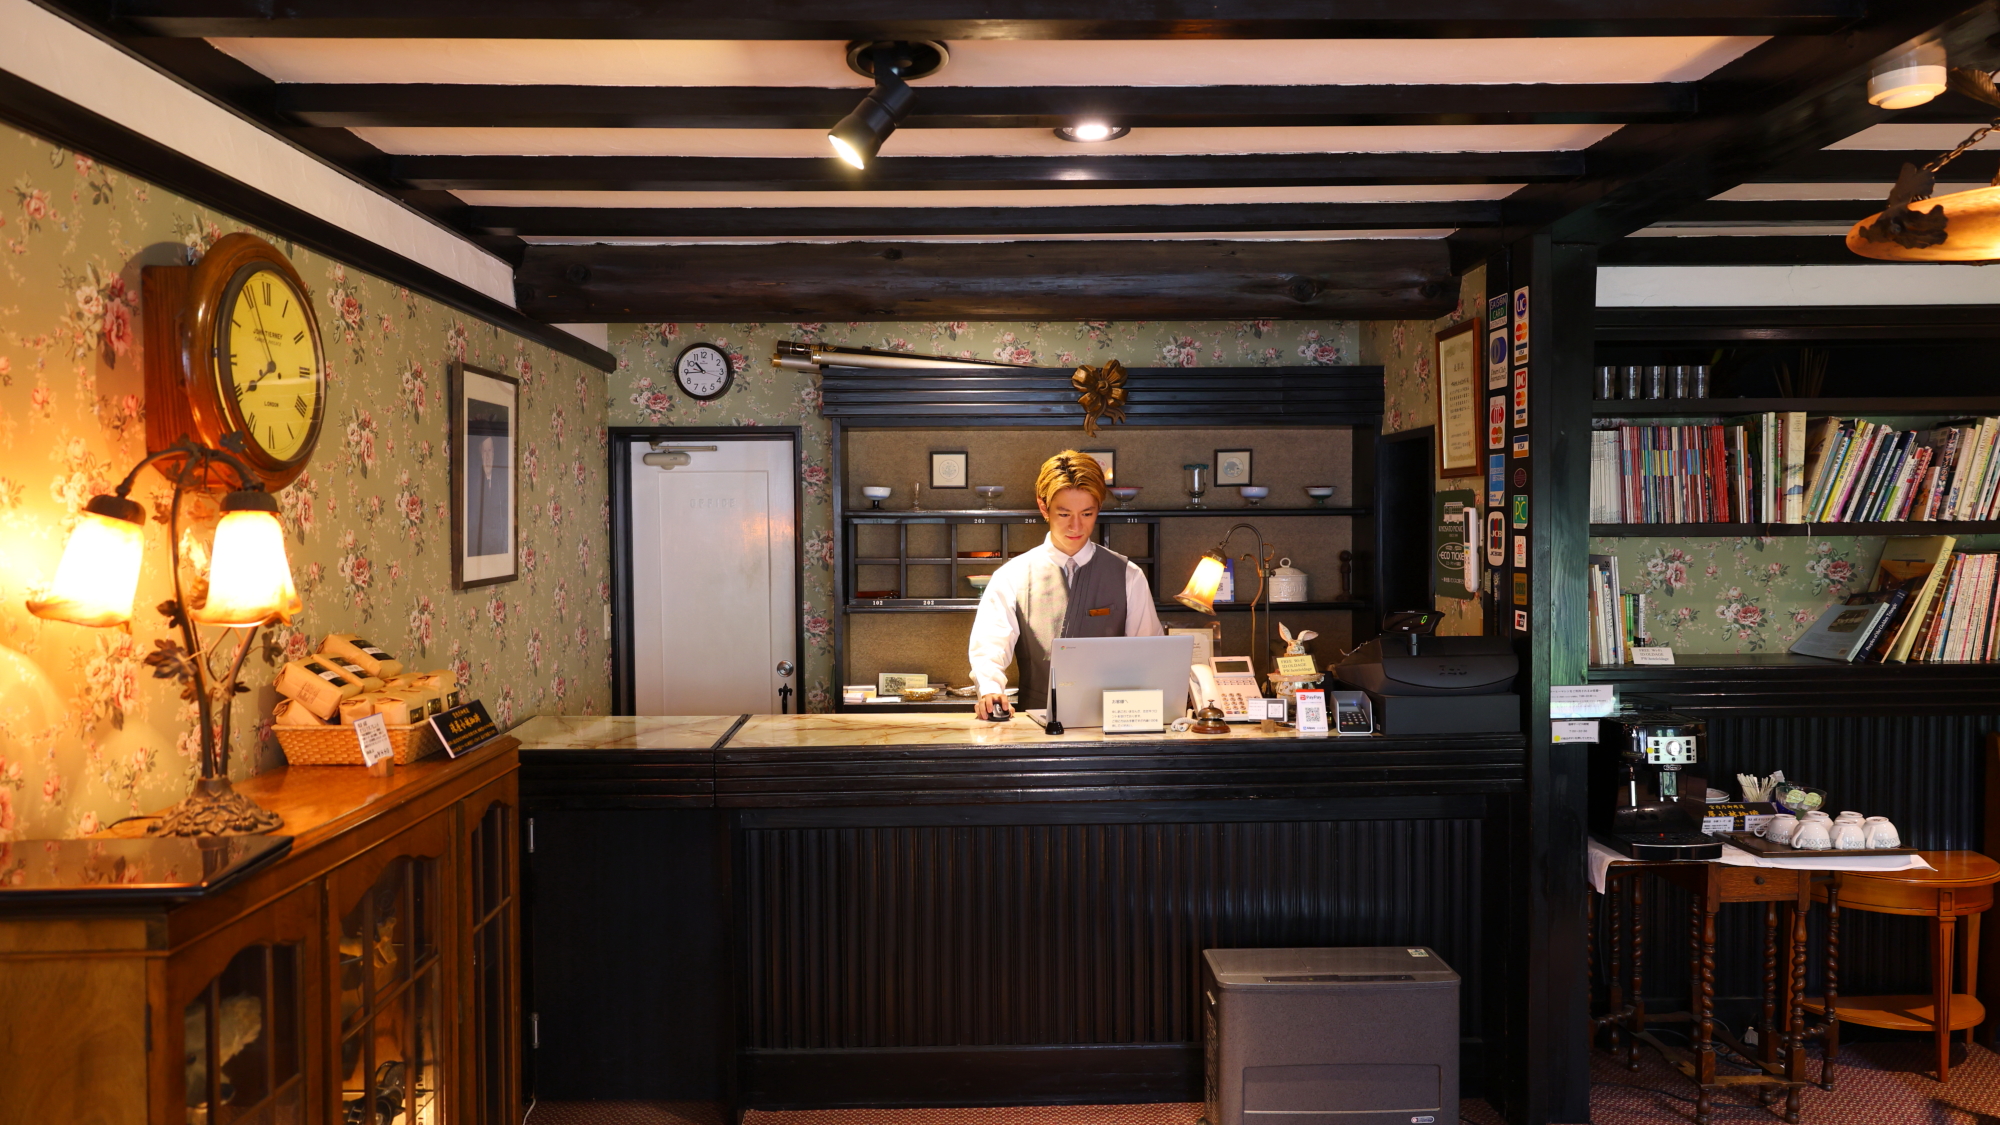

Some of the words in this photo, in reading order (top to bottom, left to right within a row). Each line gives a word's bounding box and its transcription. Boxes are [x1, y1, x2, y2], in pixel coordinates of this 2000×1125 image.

[1490, 294, 1508, 310] SAISON
[1517, 298, 1526, 312] UC
[1493, 308, 1504, 319] CARD
[690, 498, 736, 508] OFFICE
[1440, 551, 1450, 560] ECO
[1865, 638, 1875, 651] Peoples
[1879, 616, 1889, 630] Golden
[1886, 603, 1897, 616] Triangle
[1704, 810, 1759, 818] 屋小林珈琲
